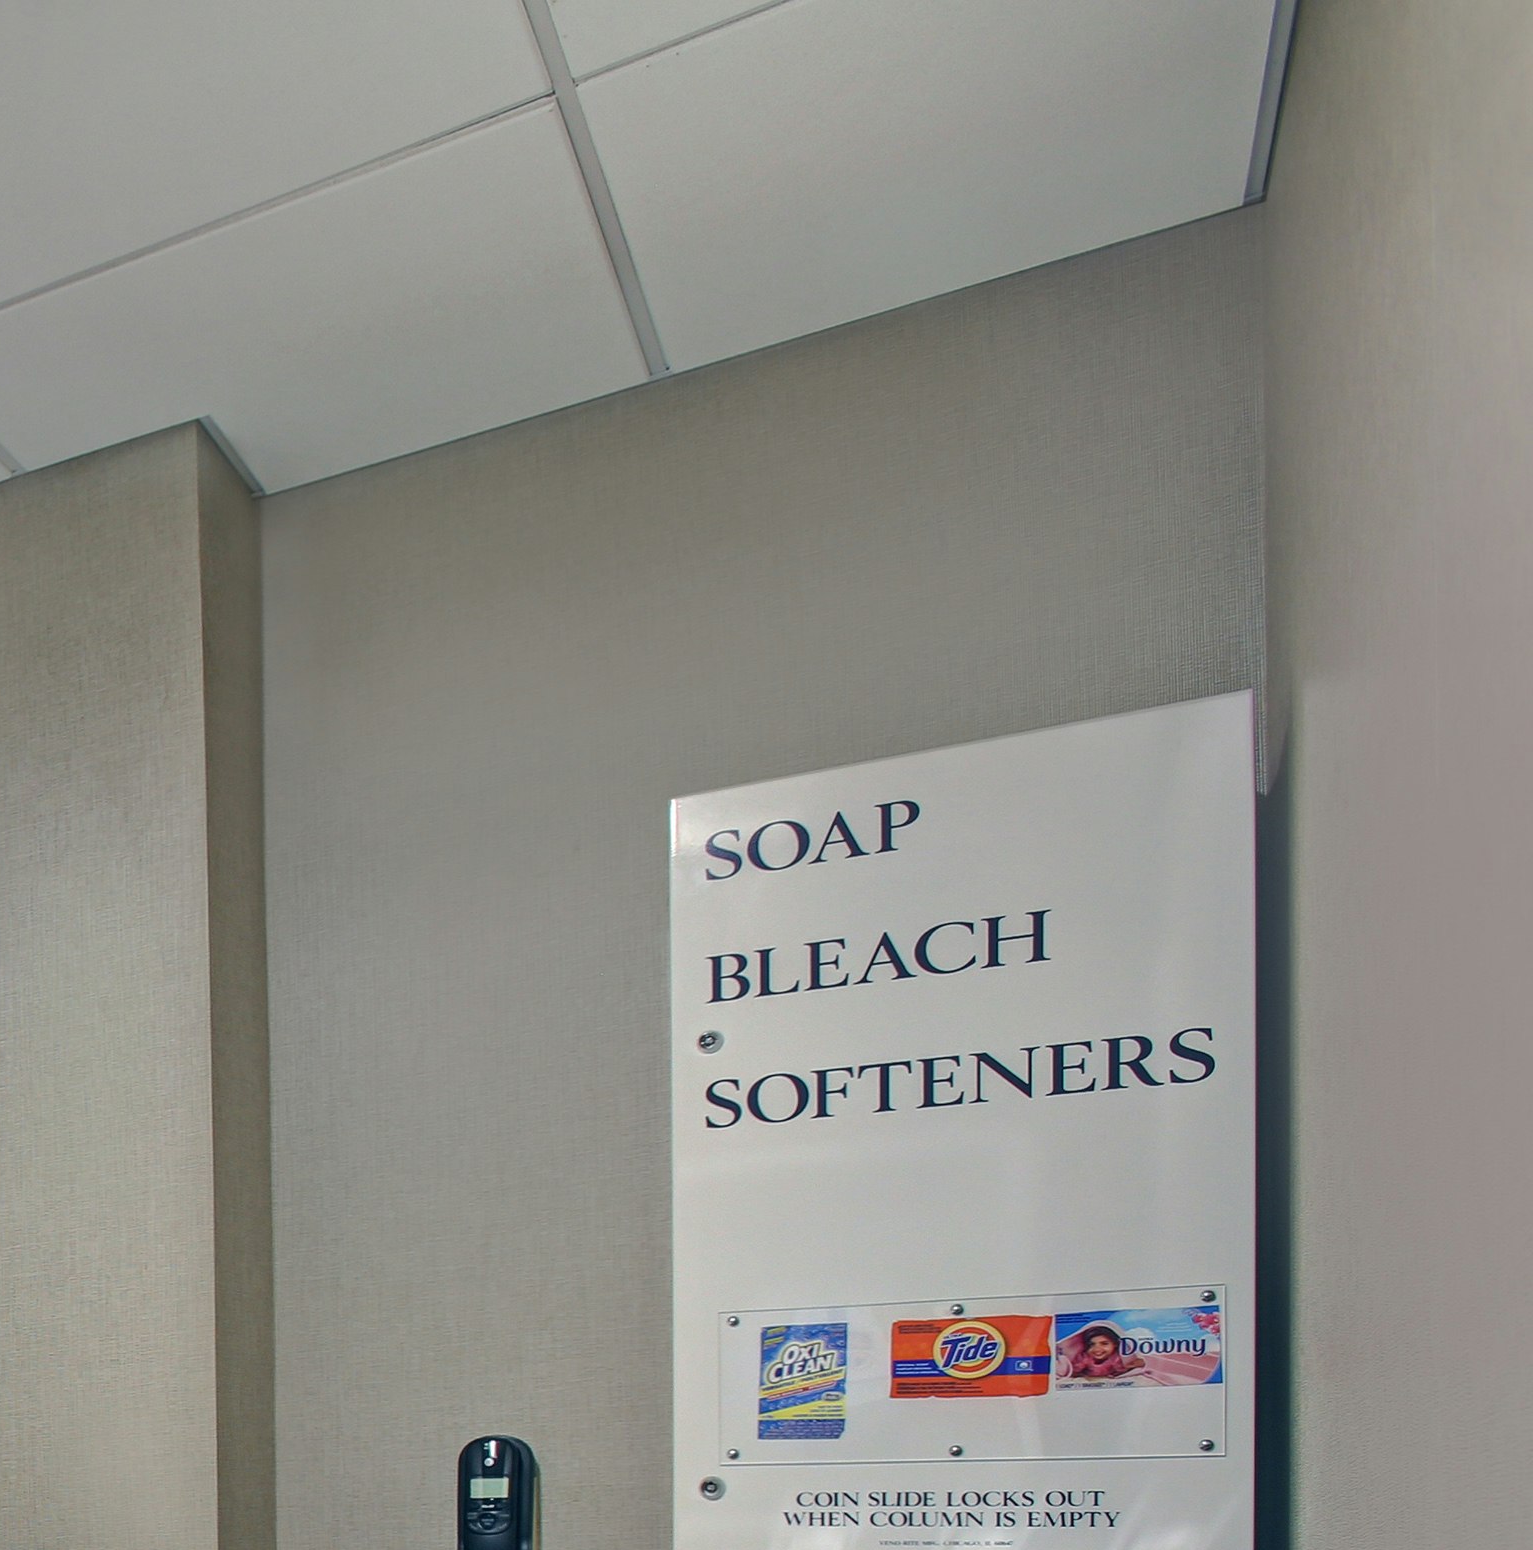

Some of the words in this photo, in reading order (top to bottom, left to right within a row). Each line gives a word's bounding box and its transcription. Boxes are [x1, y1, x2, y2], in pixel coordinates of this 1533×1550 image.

[703, 799, 921, 881] SOAP
[705, 909, 1052, 1004] BLEACH
[703, 1027, 1216, 1130] SOFTENERS
[782, 1343, 821, 1365] OXI
[941, 1335, 999, 1369] Tide
[1119, 1337, 1206, 1357] Downy
[768, 1353, 834, 1383] CLEAN
[796, 1491, 860, 1508] COIN
[868, 1491, 935, 1508] SLIDE
[947, 1491, 1035, 1508] LOCKS
[1045, 1490, 1105, 1508] OUT
[783, 1511, 860, 1527] WHEN
[869, 1511, 984, 1527] COLUMN
[995, 1511, 1016, 1527] IS
[1027, 1511, 1120, 1528] EMPTY
